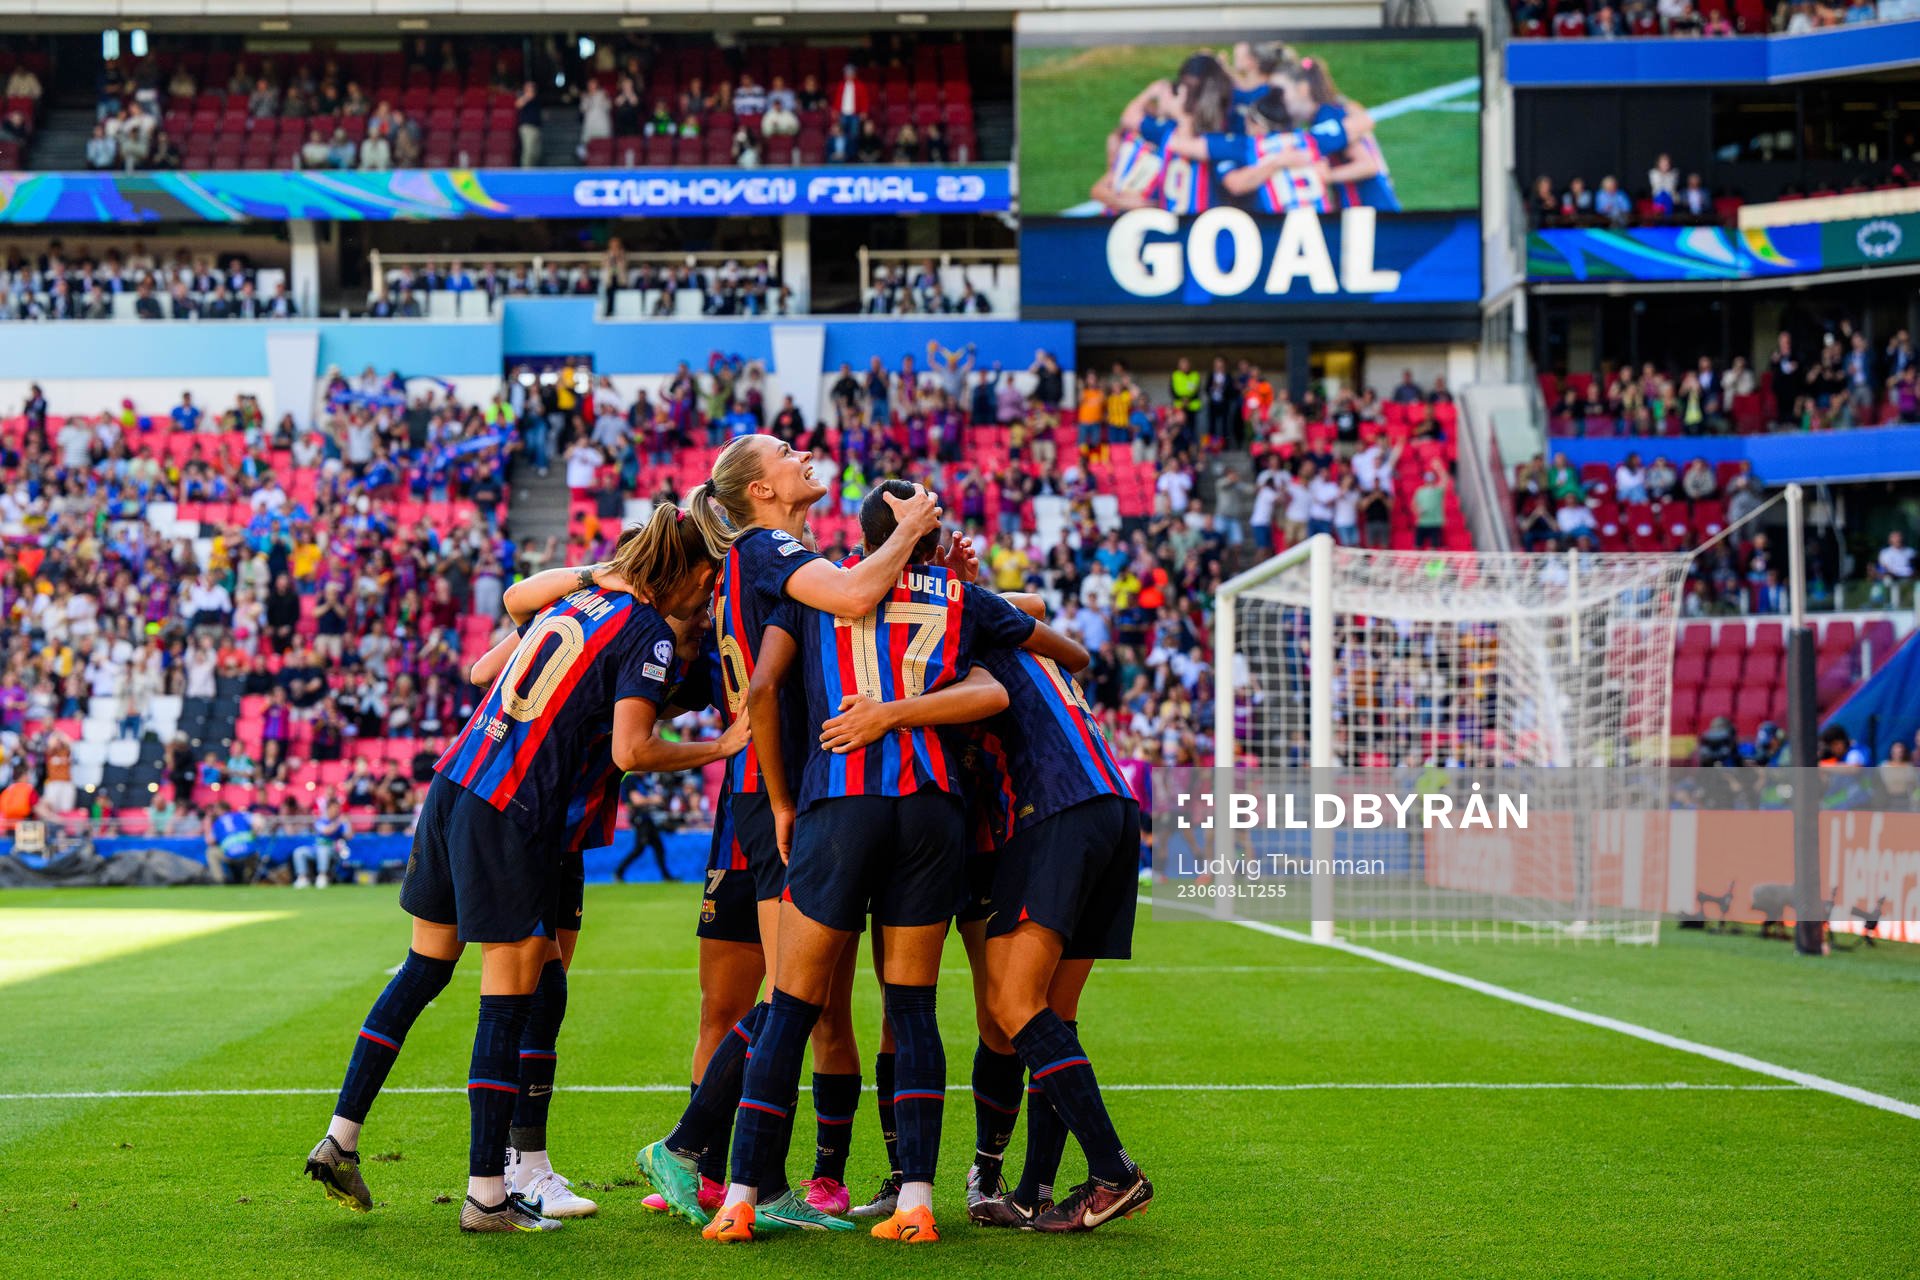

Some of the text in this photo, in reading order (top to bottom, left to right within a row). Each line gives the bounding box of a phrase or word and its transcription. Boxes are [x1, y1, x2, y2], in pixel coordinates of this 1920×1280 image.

[573, 175, 985, 206] EINDHOVEN FINAL 23
[1106, 206, 1400, 296] GOAL
[834, 601, 949, 703] 17
